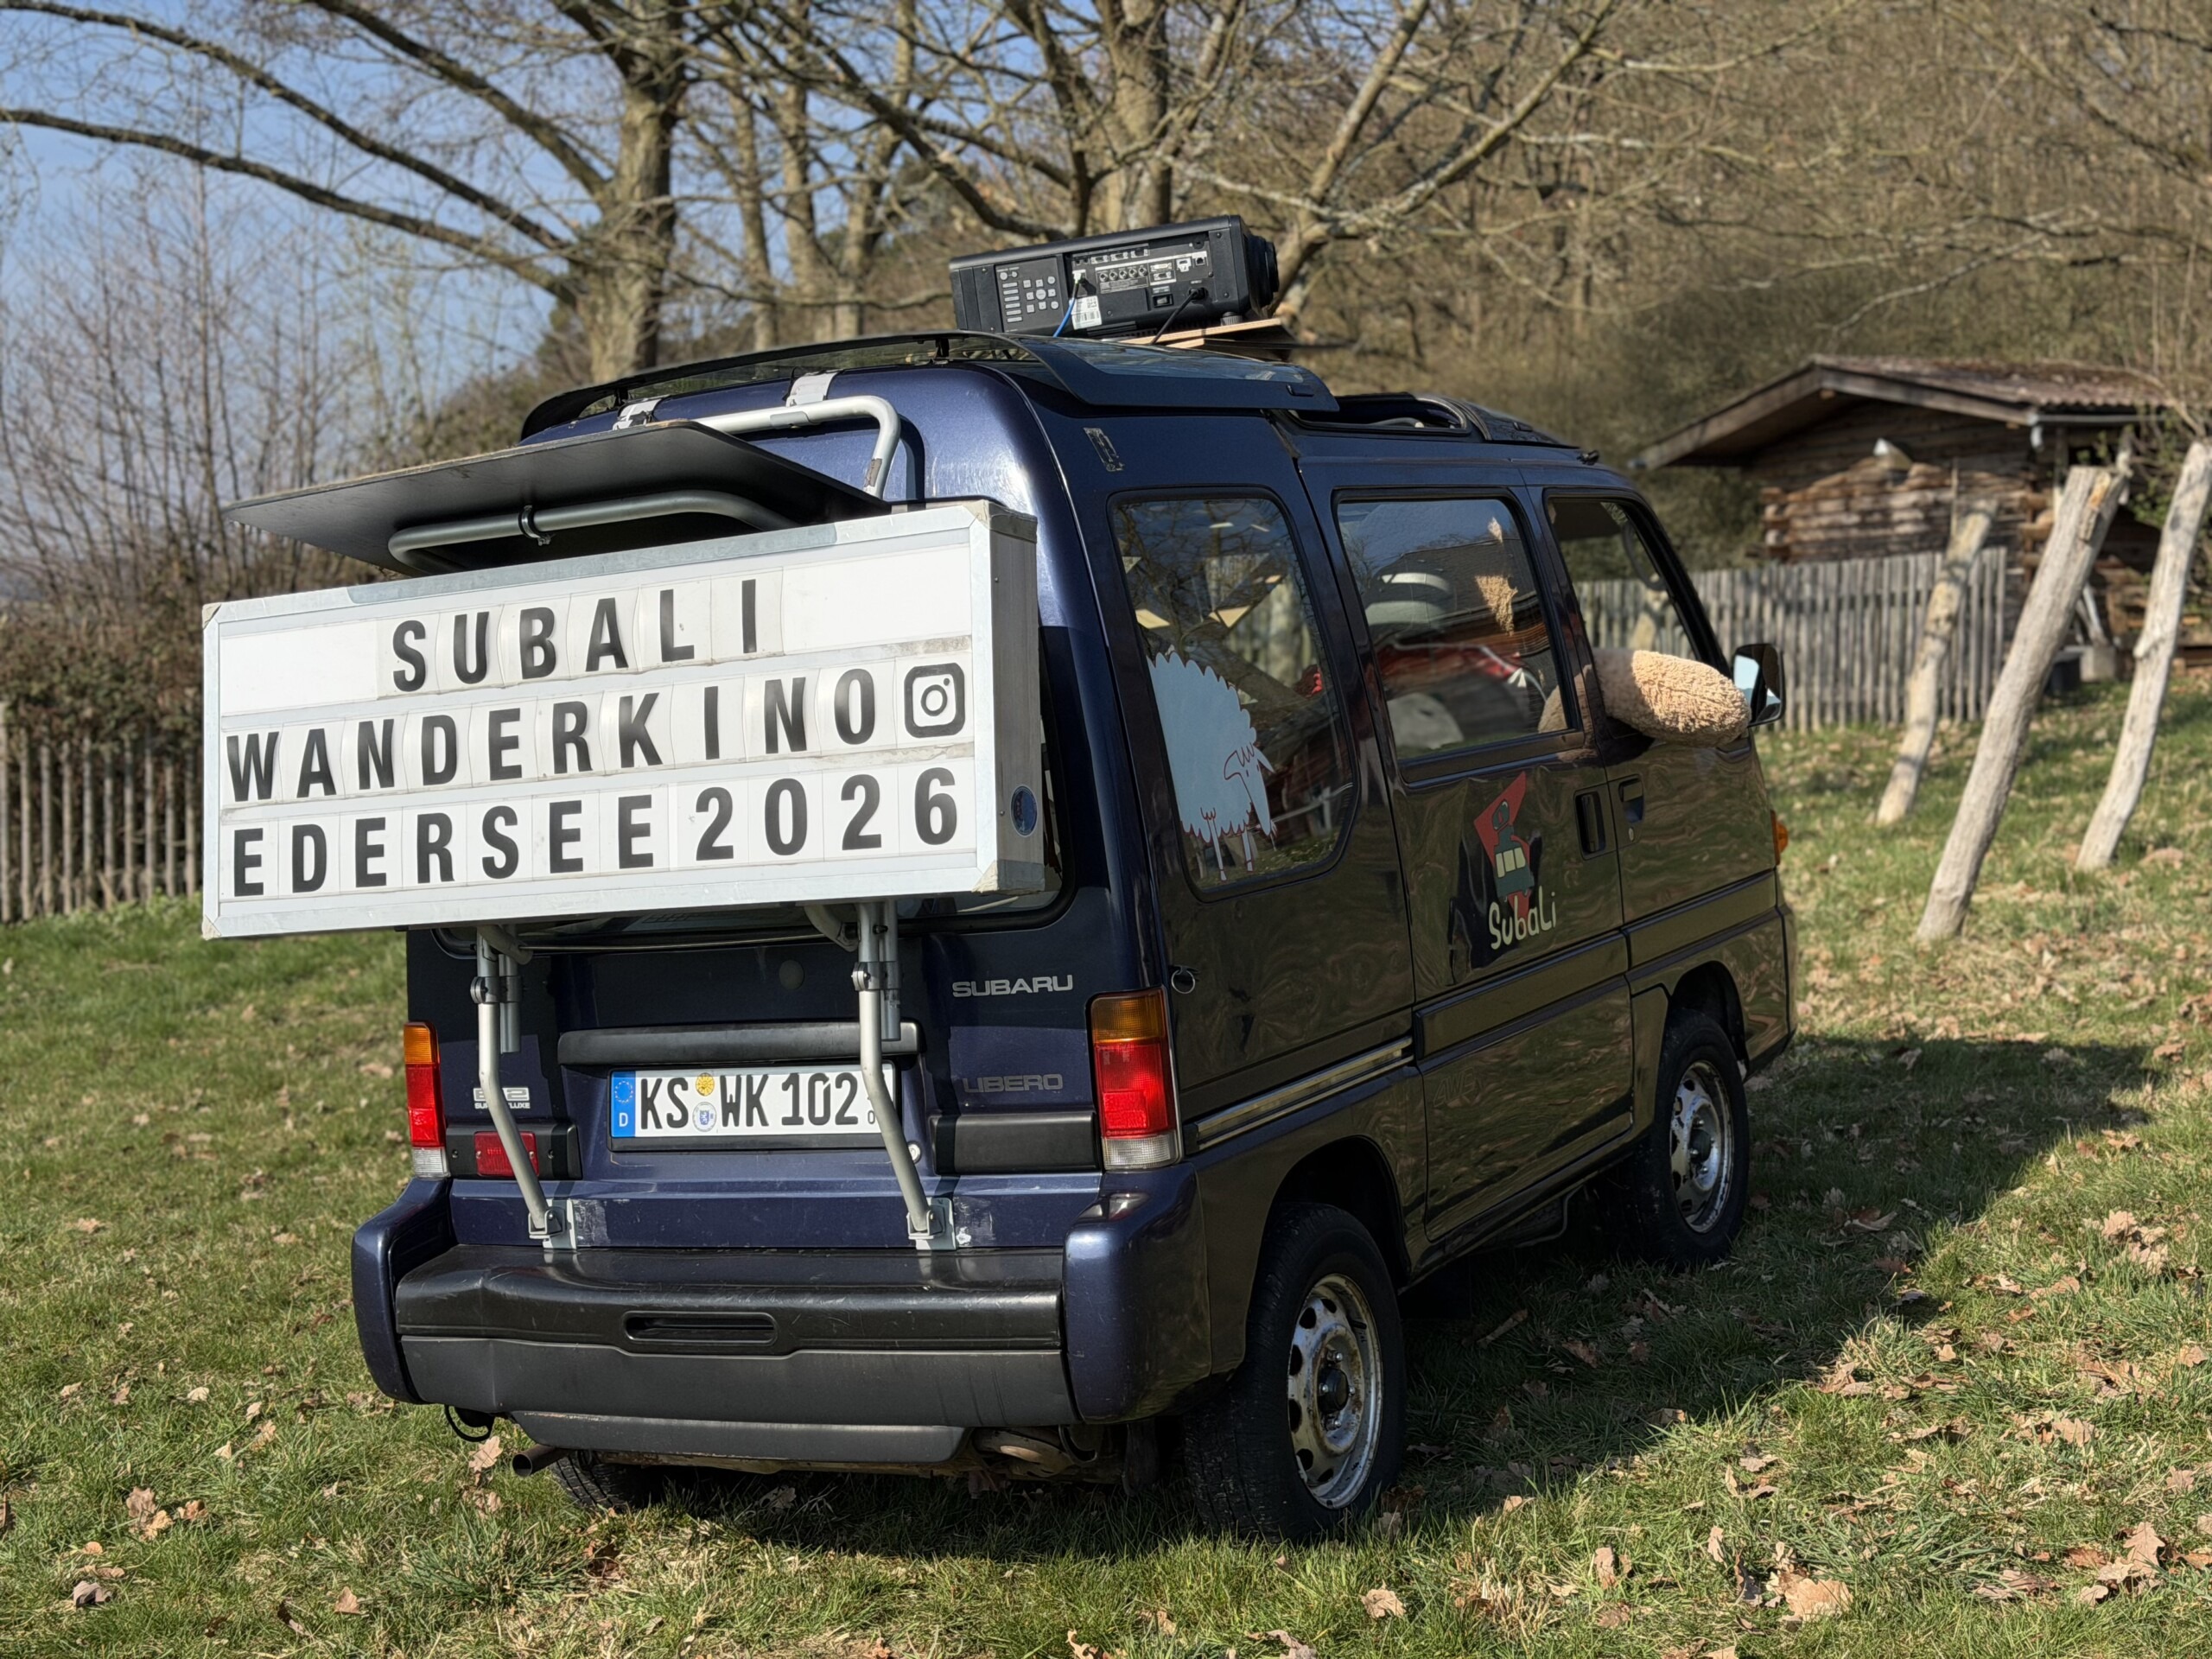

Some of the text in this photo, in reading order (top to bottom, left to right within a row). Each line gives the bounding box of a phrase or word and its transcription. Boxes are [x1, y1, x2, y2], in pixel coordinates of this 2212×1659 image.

[391, 578, 758, 693] SUBALI
[226, 667, 876, 803] WANDERKINO
[232, 766, 958, 897] EDERSEE 2026
[952, 974, 1073, 998] SUBARU
[474, 1088, 530, 1102] E2
[640, 1071, 859, 1129] KS WK 102
[963, 1073, 1064, 1094] LIBERO
[619, 1112, 628, 1127] D
